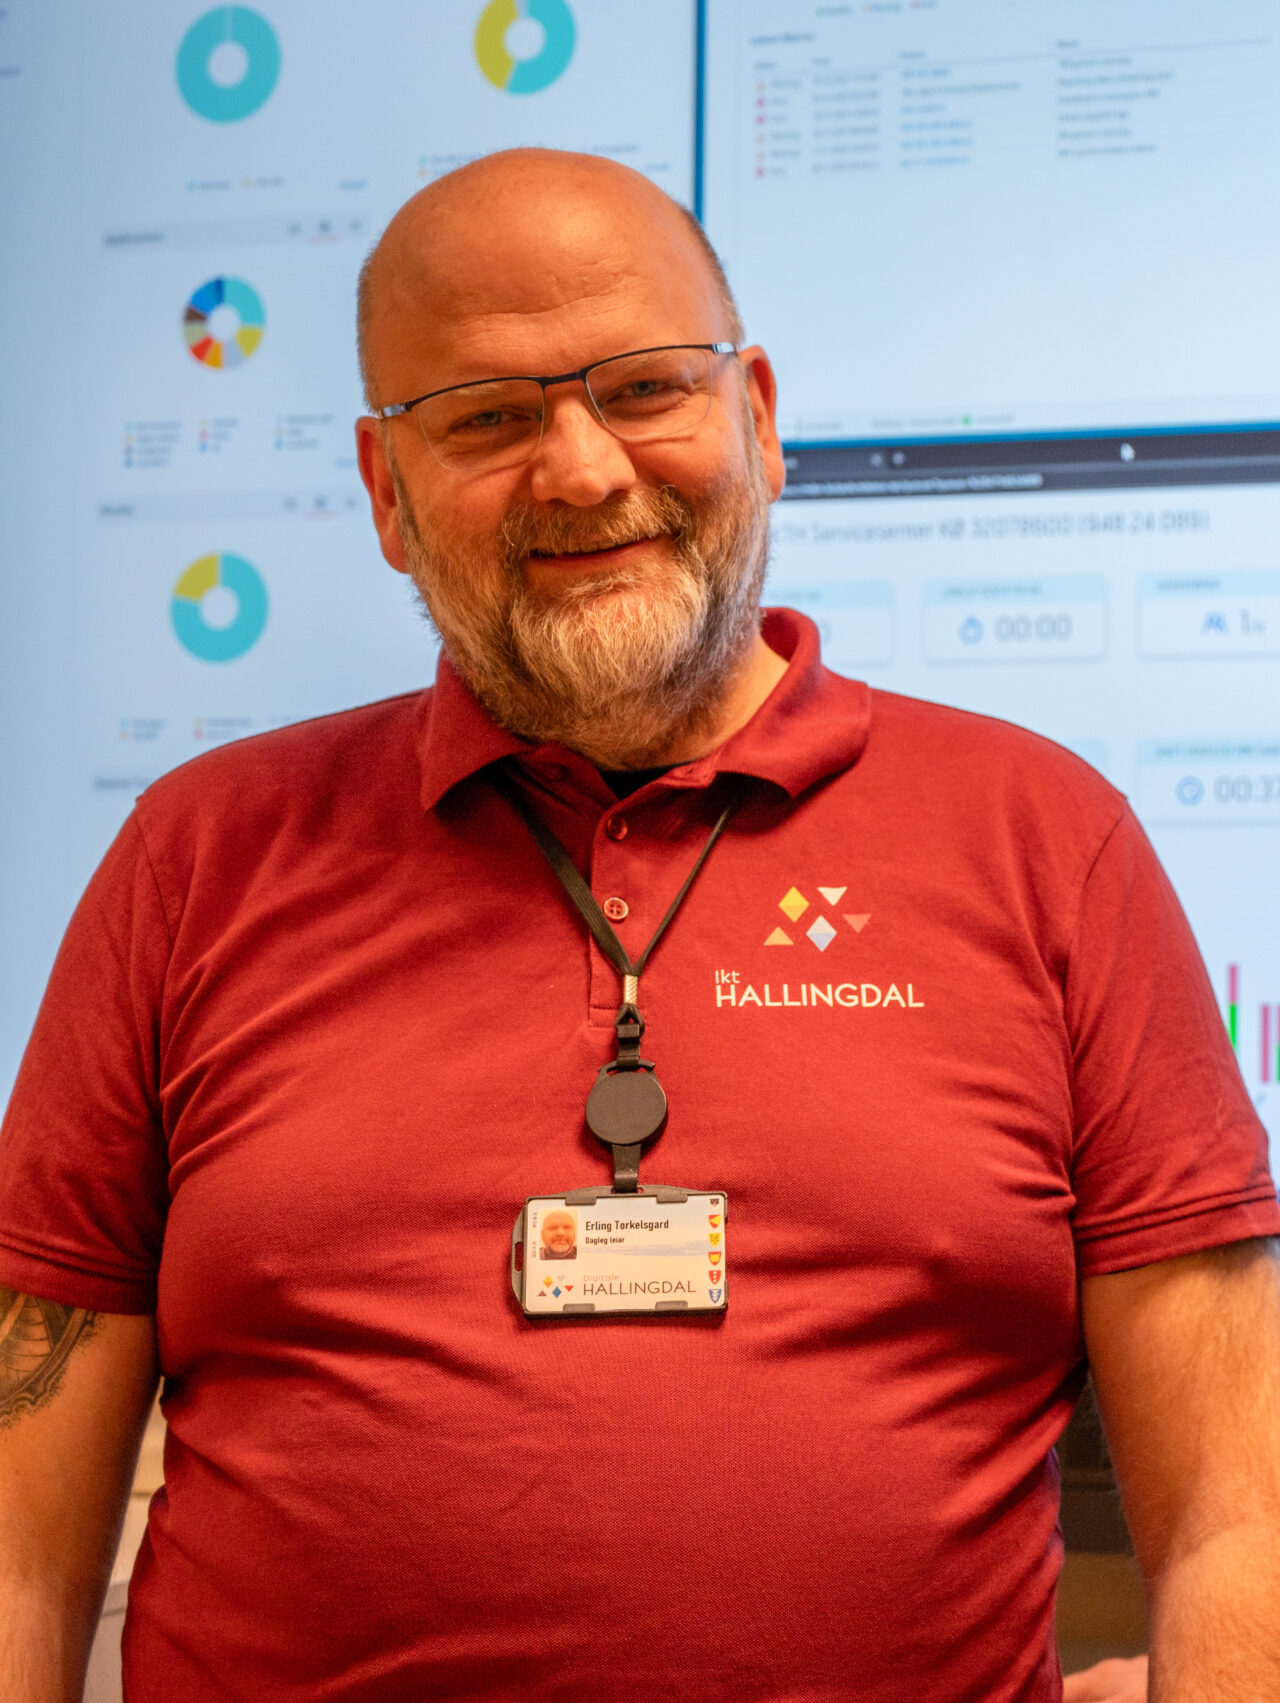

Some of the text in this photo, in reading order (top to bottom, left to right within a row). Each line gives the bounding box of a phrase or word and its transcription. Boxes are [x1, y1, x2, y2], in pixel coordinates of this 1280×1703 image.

[993, 613, 1072, 643] 00:00
[716, 983, 925, 1008] HALLINGDAL
[585, 1219, 669, 1232] Erling Torkelsgard
[585, 1237, 608, 1245] Dagleg
[583, 1280, 697, 1296] HALLINGDAL
